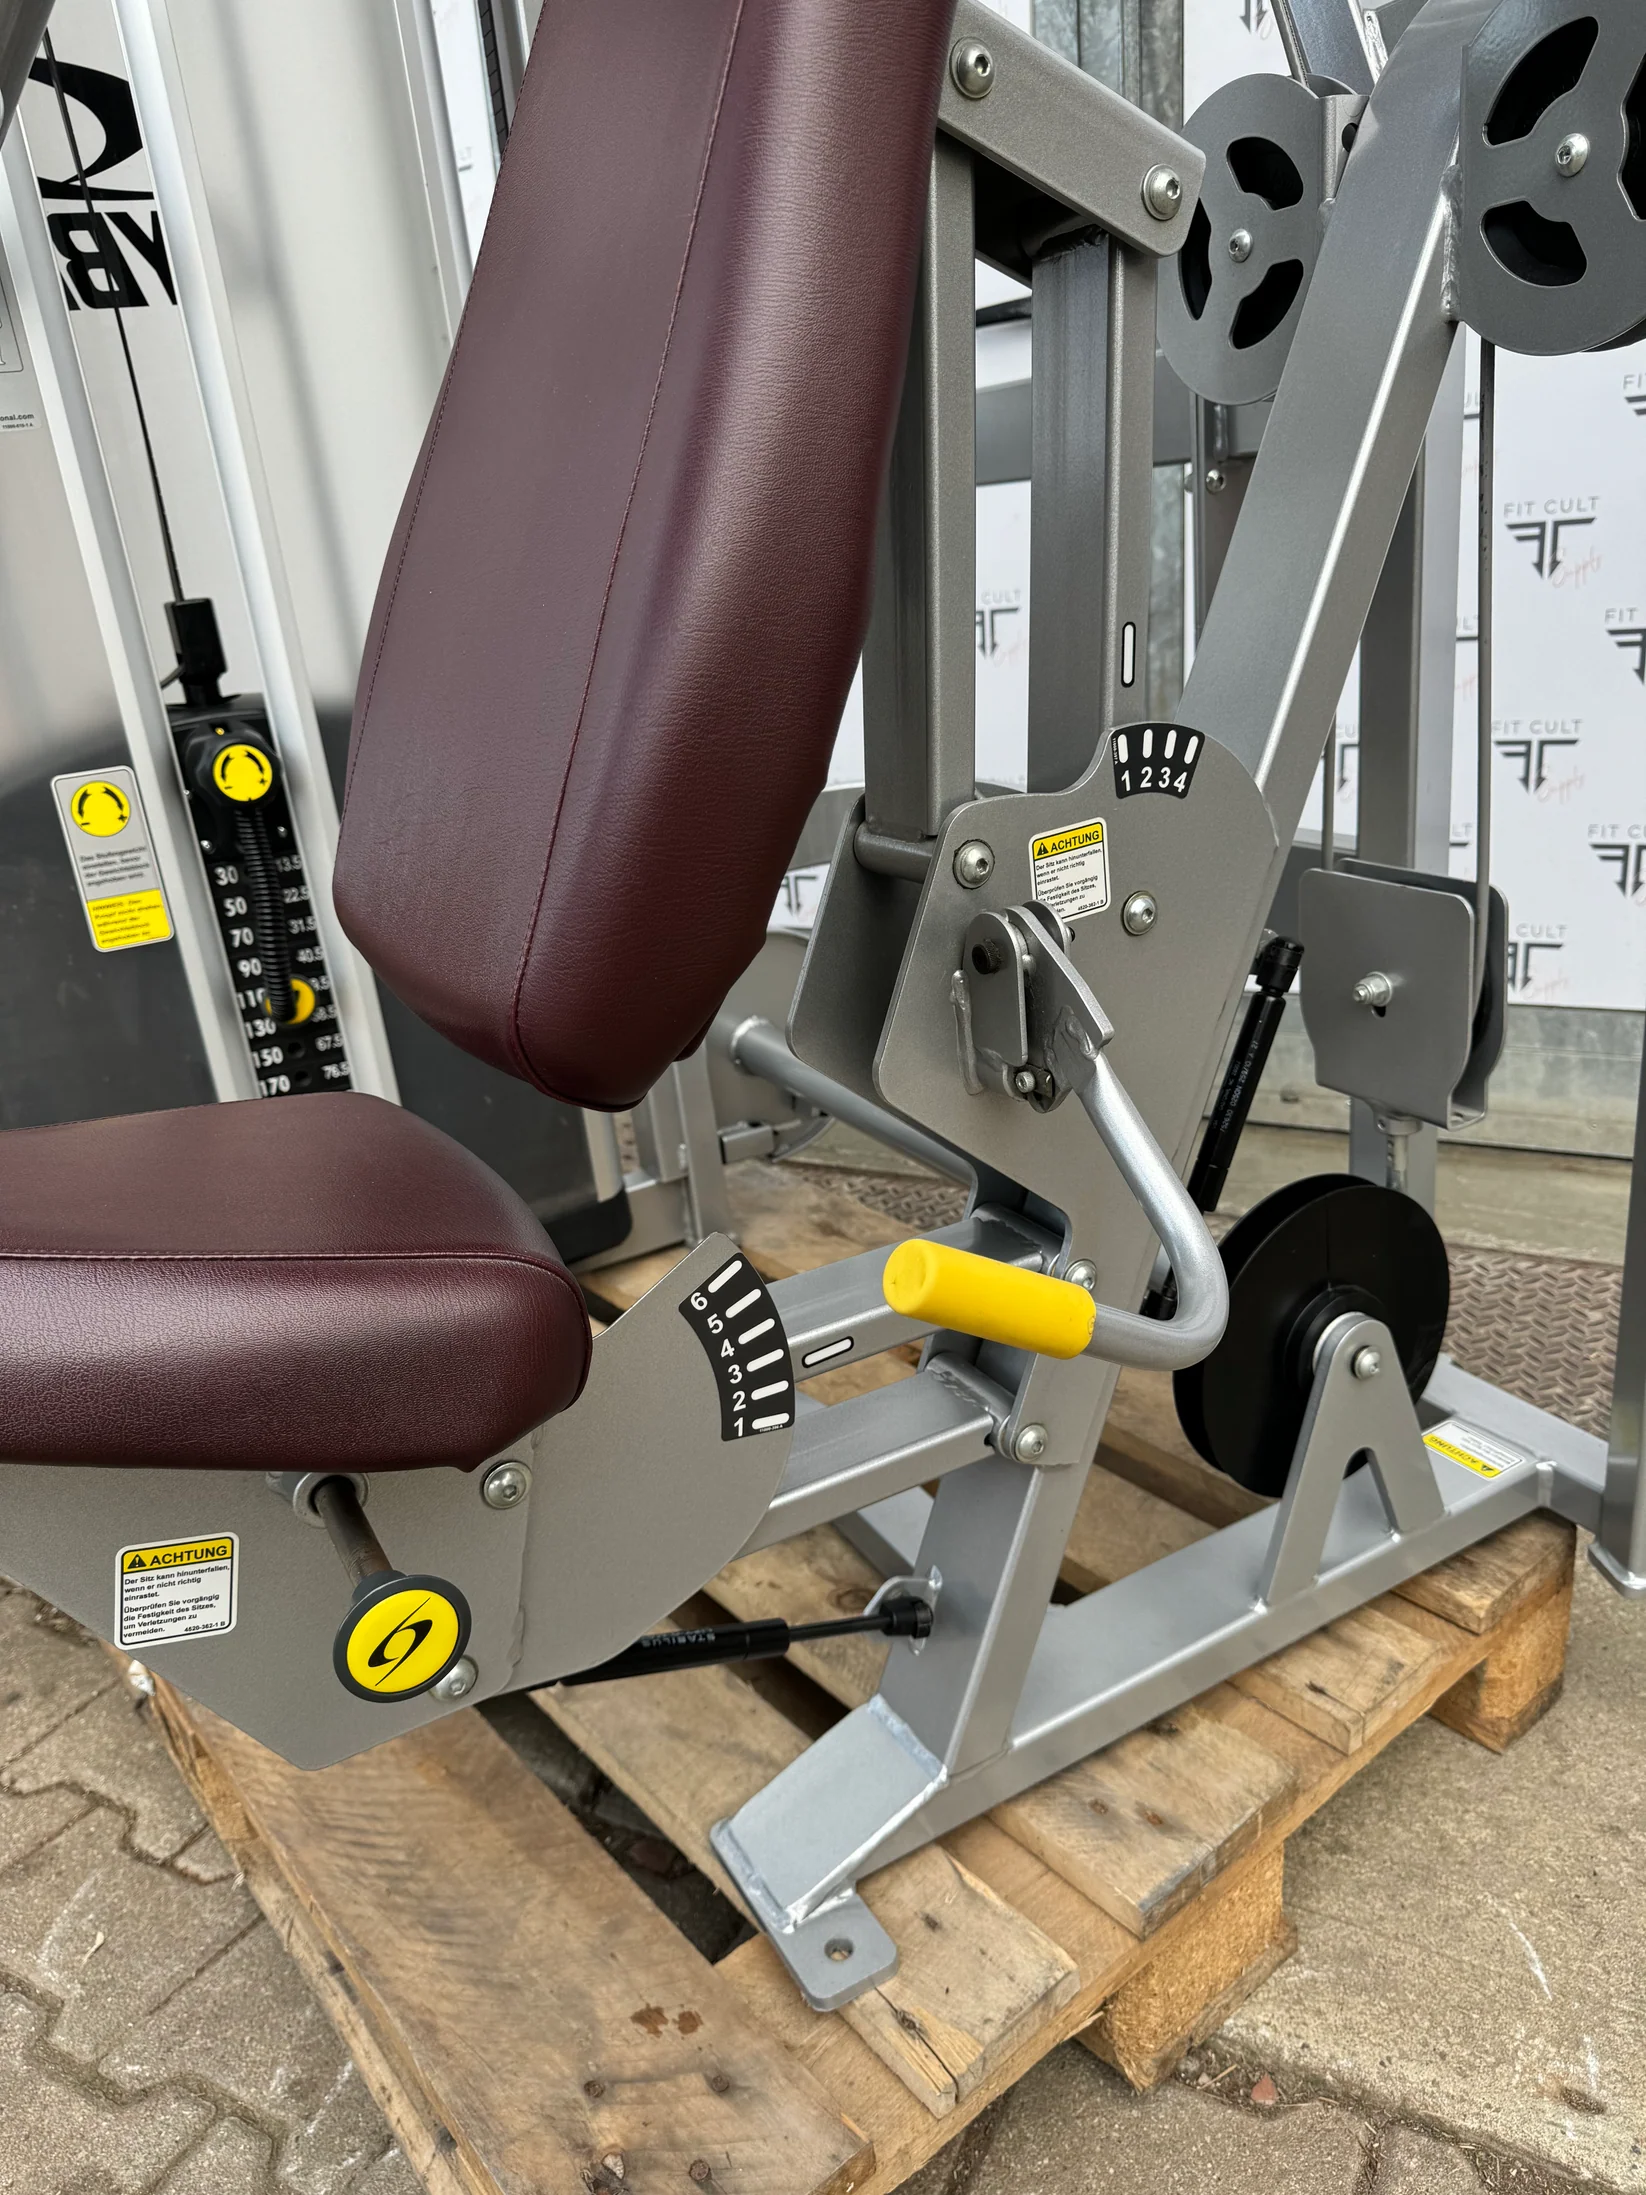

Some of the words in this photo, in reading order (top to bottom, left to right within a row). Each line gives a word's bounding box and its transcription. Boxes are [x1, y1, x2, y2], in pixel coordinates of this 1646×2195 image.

[1504, 501, 1536, 518] FIT
[1544, 496, 1600, 514] CULT
[1605, 607, 1639, 624] FIT
[1529, 719, 1583, 735] CULT
[1121, 770, 1131, 791] 1
[1140, 766, 1152, 788] 2
[1159, 766, 1170, 788] 3
[1174, 772, 1188, 792] 4
[1051, 831, 1099, 852] ACHTUNG
[1588, 824, 1621, 839] FIT
[214, 865, 239, 886] 30
[1047, 890, 1070, 900] Festigkeit
[224, 896, 248, 917] 50
[229, 927, 254, 948] 70
[1516, 923, 1567, 938] CULT
[237, 958, 262, 978] 90
[245, 1018, 276, 1039] 130
[252, 1046, 283, 1069] 150
[260, 1075, 291, 1097] 170
[690, 1292, 708, 1311] 6
[706, 1313, 724, 1334] 5
[720, 1338, 735, 1358] 4
[728, 1364, 743, 1384] 3
[732, 1391, 746, 1411] 2
[733, 1417, 744, 1437] 1
[150, 1545, 227, 1566] ACHTUNG
[157, 1580, 176, 1589] nicht
[178, 1576, 201, 1585] richtig
[124, 1592, 159, 1601] einrastet.
[124, 1603, 166, 1614] Überprüfen
[182, 1593, 219, 1605] vorgängig
[138, 1609, 174, 1620] Festigkeit
[138, 1615, 186, 1627] Verletzungen
[124, 1627, 165, 1638] vermeiden.
